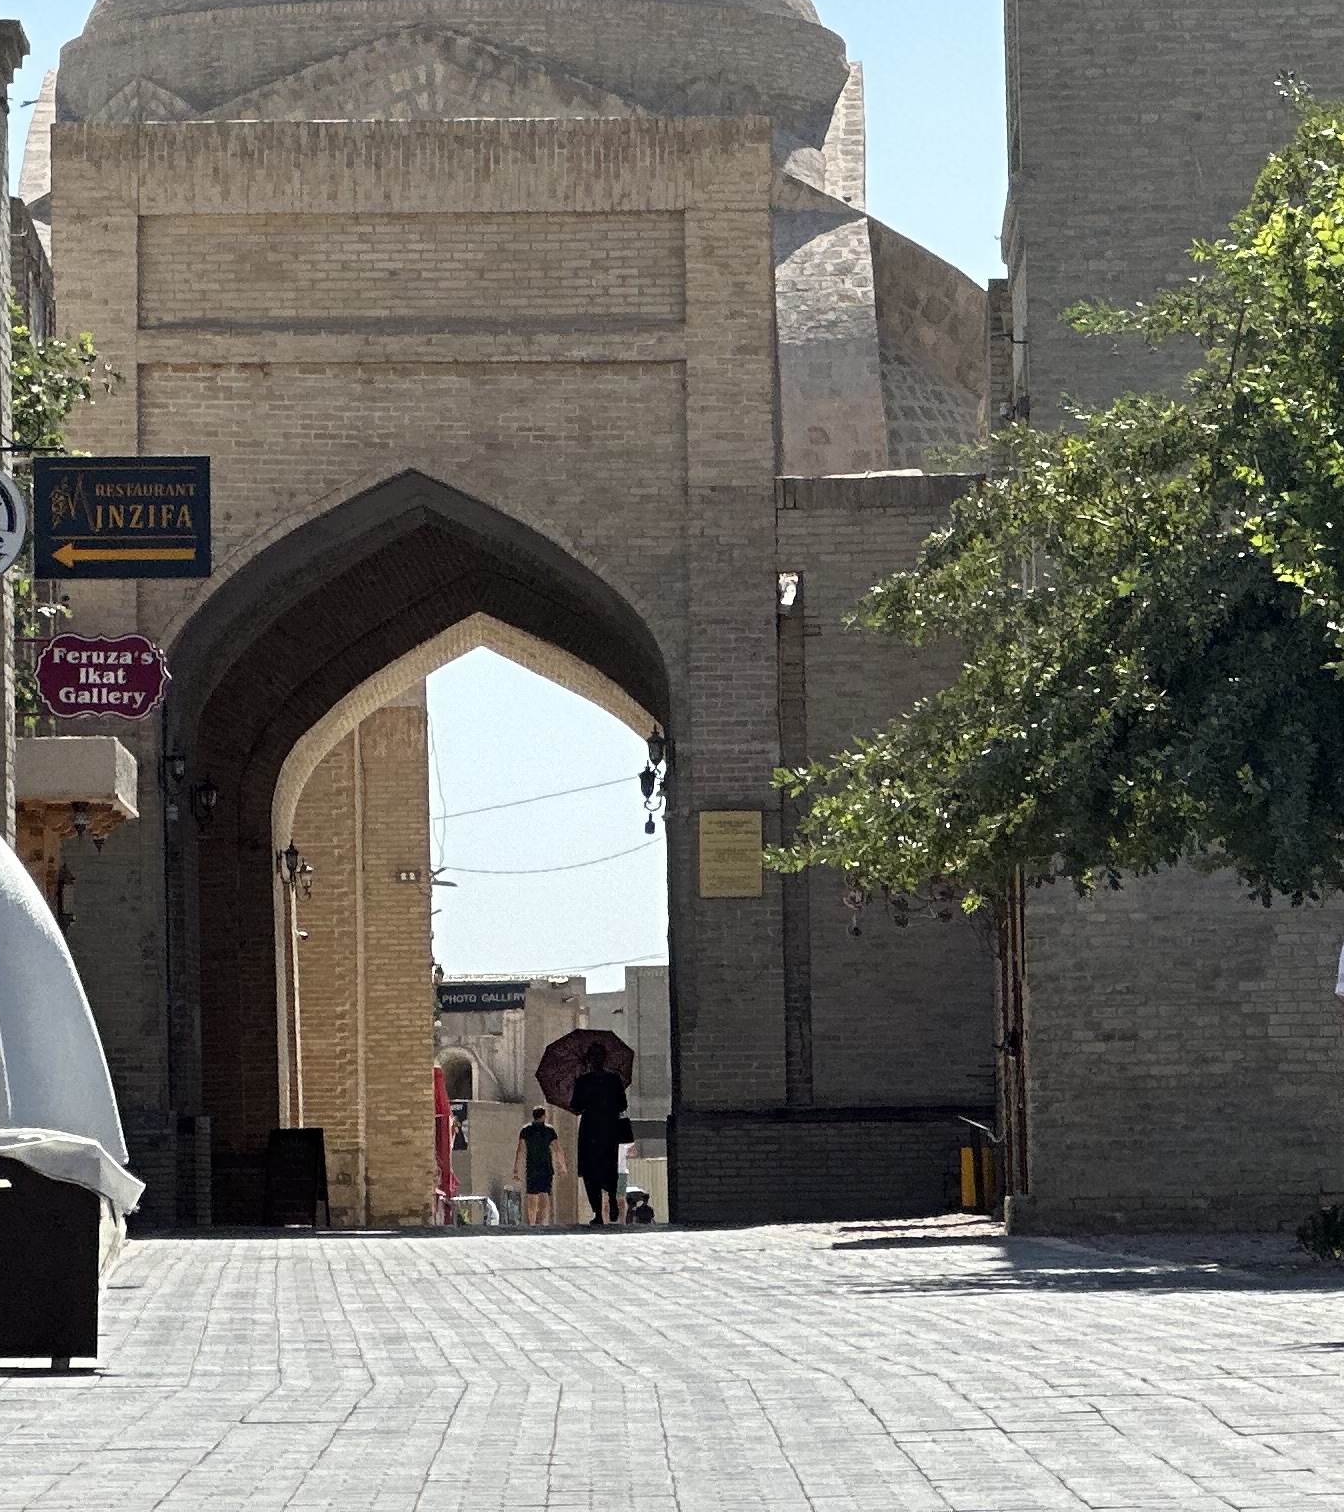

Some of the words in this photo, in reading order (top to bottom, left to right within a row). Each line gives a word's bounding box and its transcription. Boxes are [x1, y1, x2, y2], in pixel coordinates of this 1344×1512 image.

[95, 483, 197, 496] RESTAURANT
[96, 504, 193, 528] INZIFA
[52, 648, 154, 665] Feruza's
[79, 667, 127, 685] Ikat
[58, 687, 147, 709] Gallery
[442, 993, 477, 1004] PHOTO
